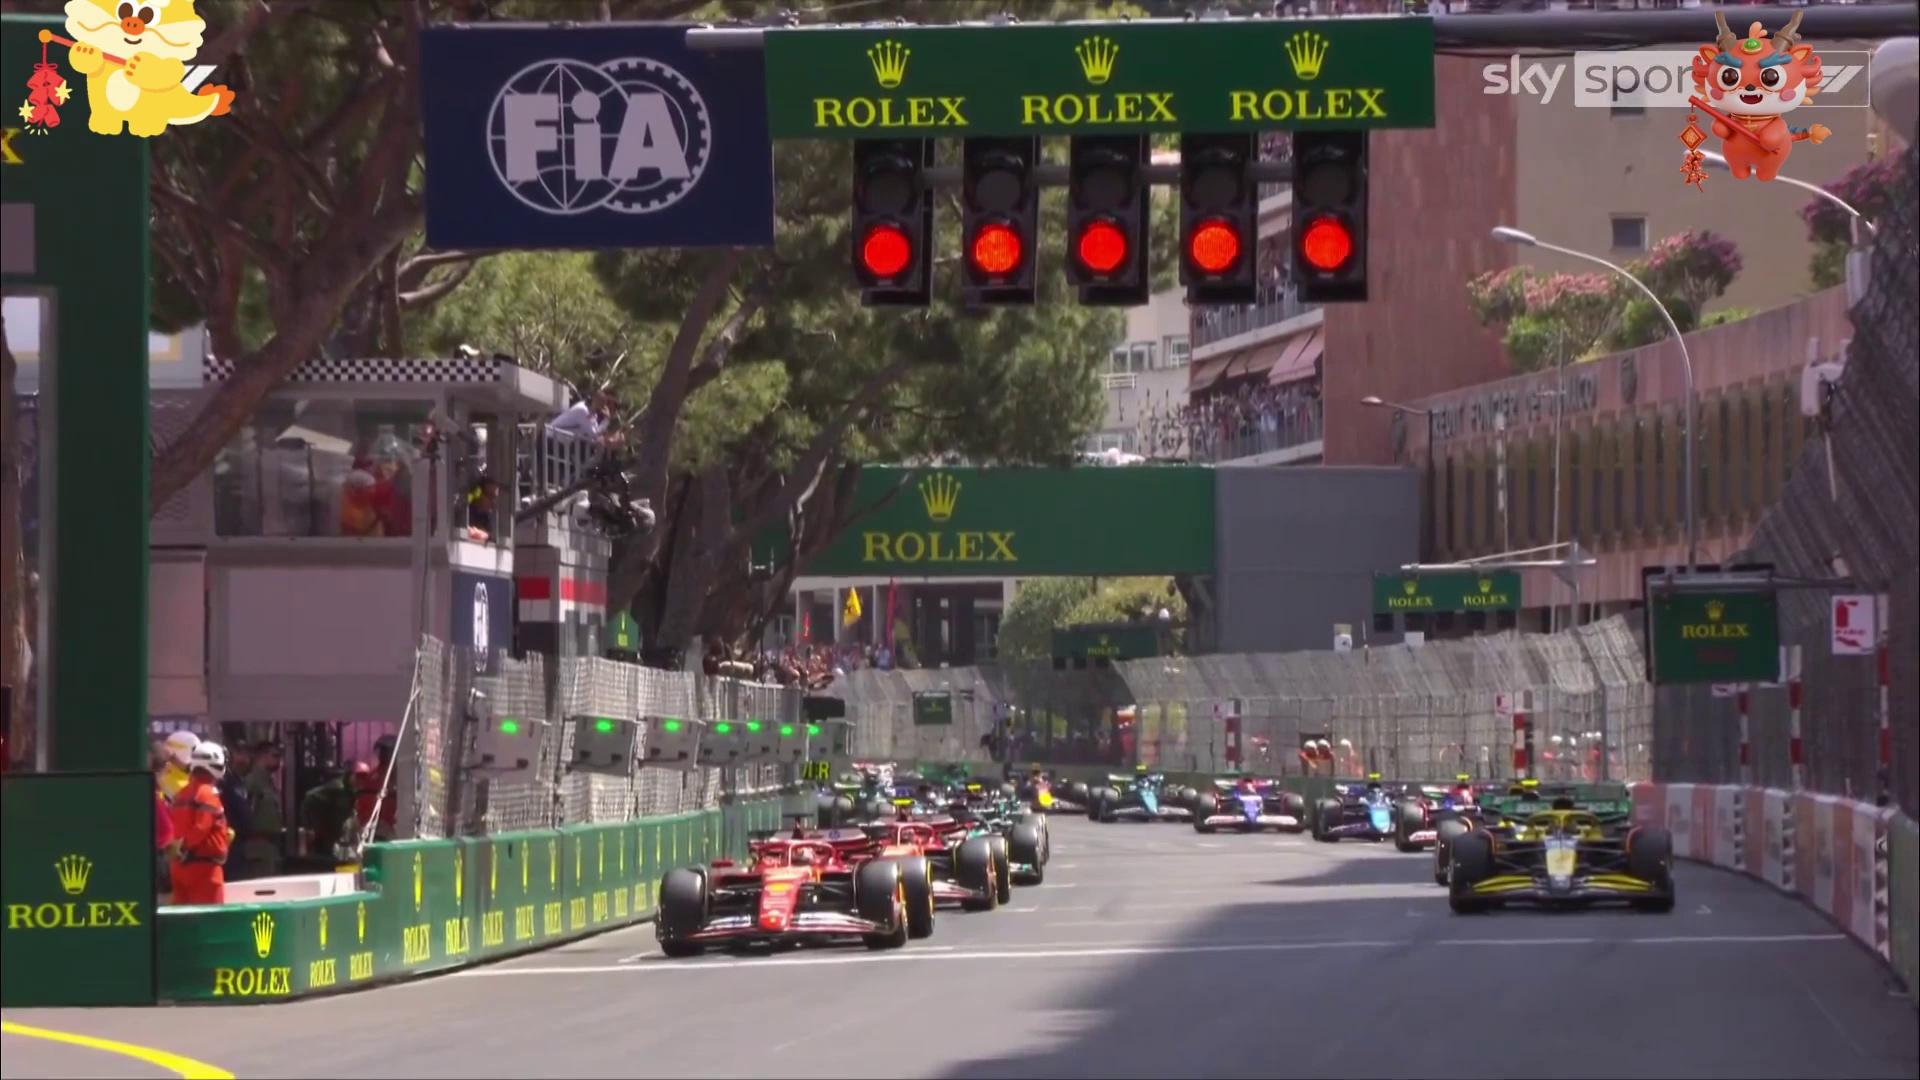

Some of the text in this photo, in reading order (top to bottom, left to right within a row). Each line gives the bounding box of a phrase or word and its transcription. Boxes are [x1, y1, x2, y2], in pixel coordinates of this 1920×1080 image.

[813, 88, 1387, 129] ROLEX ROLEX ROLEX
[863, 531, 1017, 562] ROLEX
[1388, 594, 1509, 609] ROLEX ROLEX
[1681, 624, 1749, 639] ROLEX
[7, 901, 142, 930] ROLEX
[482, 910, 504, 948] ROLEX
[403, 923, 432, 965] ROLEX
[445, 916, 470, 956] ROLEX
[213, 966, 292, 996] ROLEX
[309, 957, 337, 989] ROLEX
[349, 952, 374, 982] ROLEX
